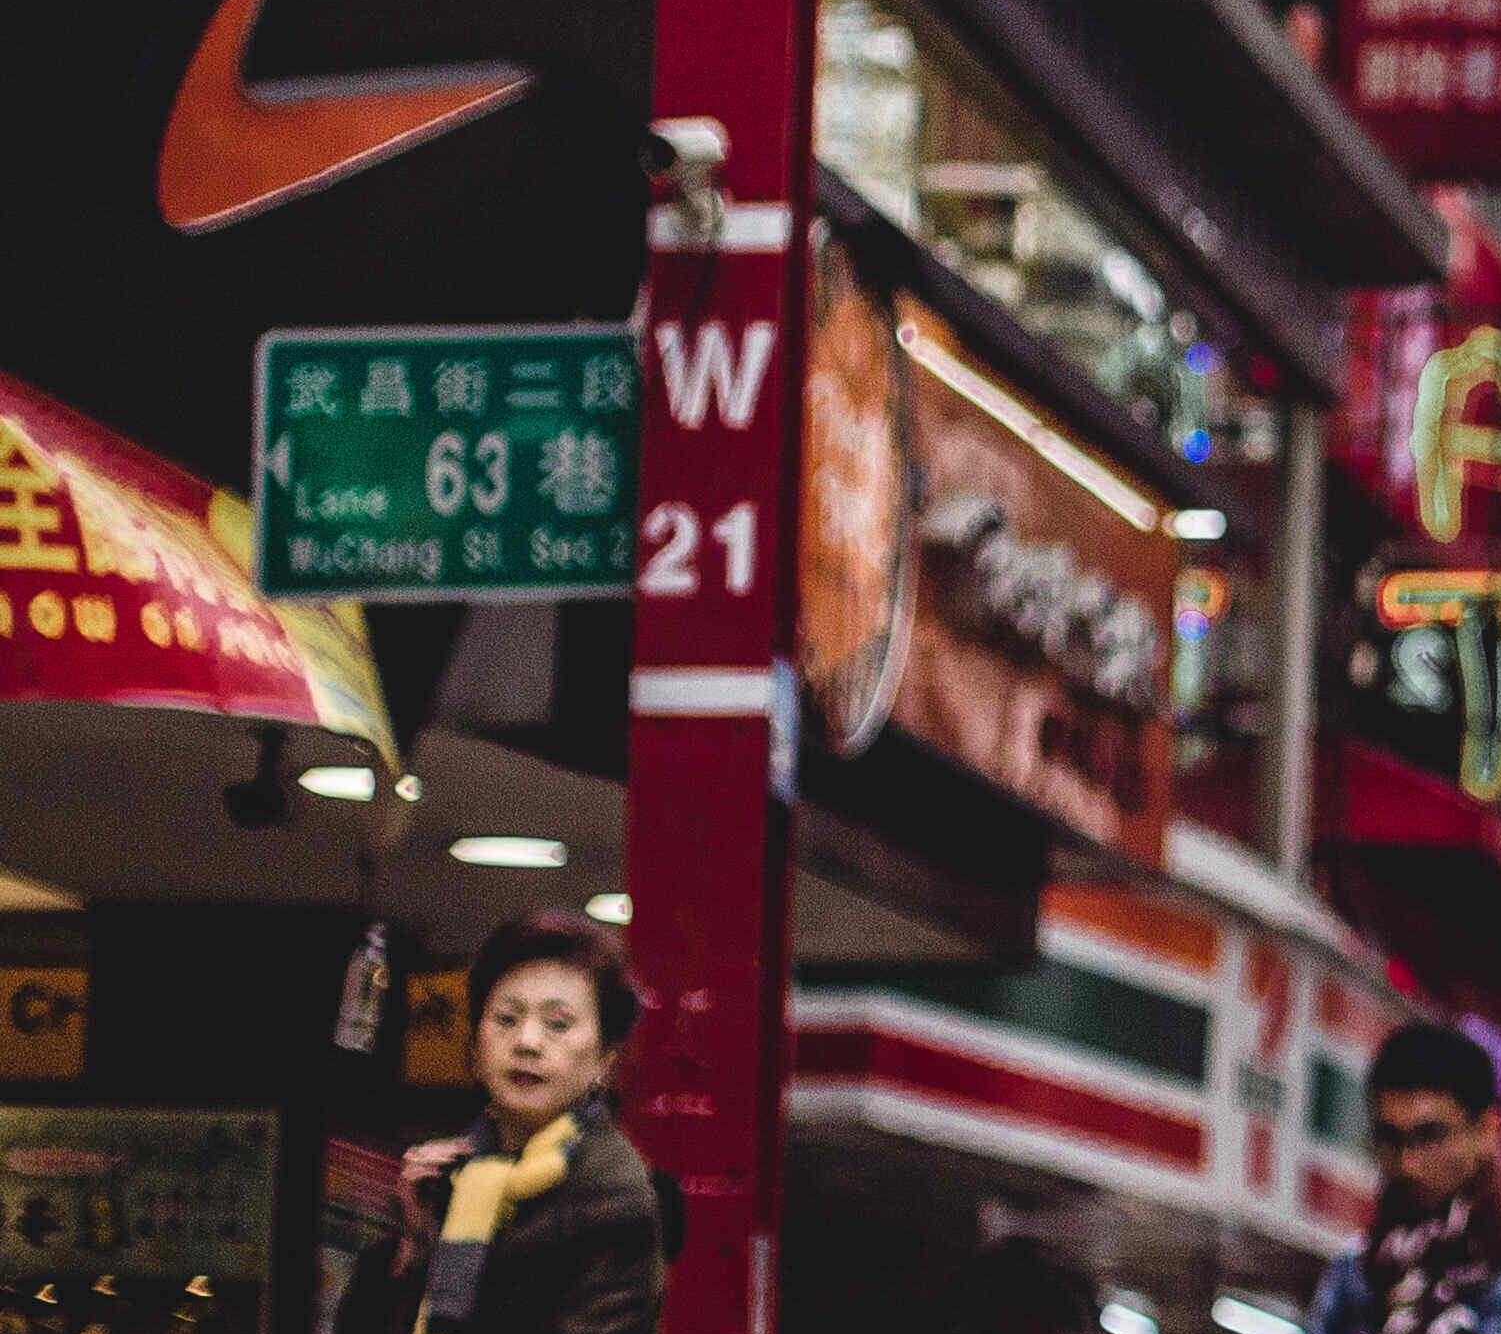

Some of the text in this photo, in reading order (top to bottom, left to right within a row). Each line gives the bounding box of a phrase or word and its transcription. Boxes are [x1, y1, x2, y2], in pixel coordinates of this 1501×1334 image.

[654, 320, 779, 430] W
[295, 482, 389, 522] Lane
[425, 428, 509, 517] 63
[640, 500, 760, 598] 21
